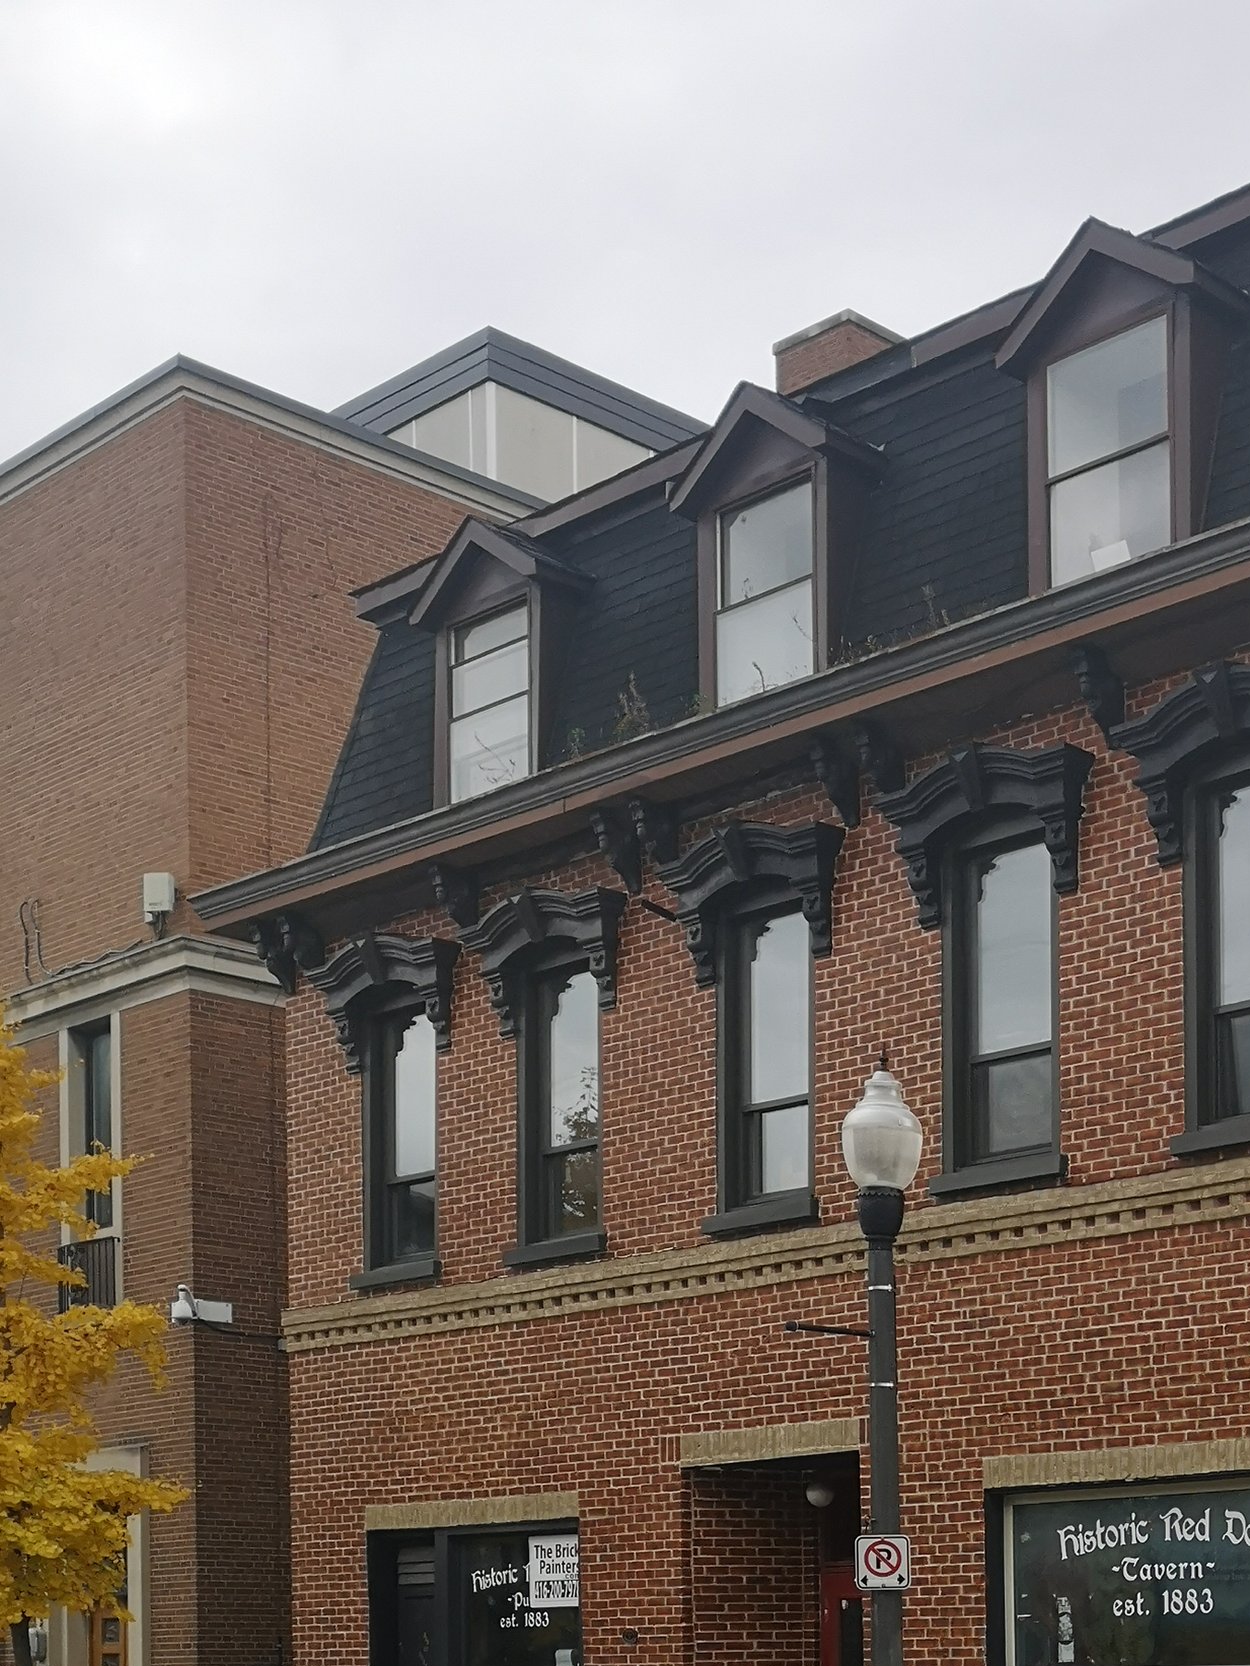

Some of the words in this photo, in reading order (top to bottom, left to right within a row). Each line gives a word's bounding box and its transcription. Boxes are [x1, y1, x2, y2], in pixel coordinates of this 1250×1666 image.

[1057, 1512, 1149, 1561] Historic
[1159, 1507, 1211, 1542] Red
[533, 1544, 553, 1559] The
[471, 1564, 518, 1592] Historic
[1112, 1592, 1150, 1617] est.
[1162, 1588, 1214, 1615] 1883
[500, 1613, 519, 1628] est.
[524, 1611, 550, 1628] 1883
